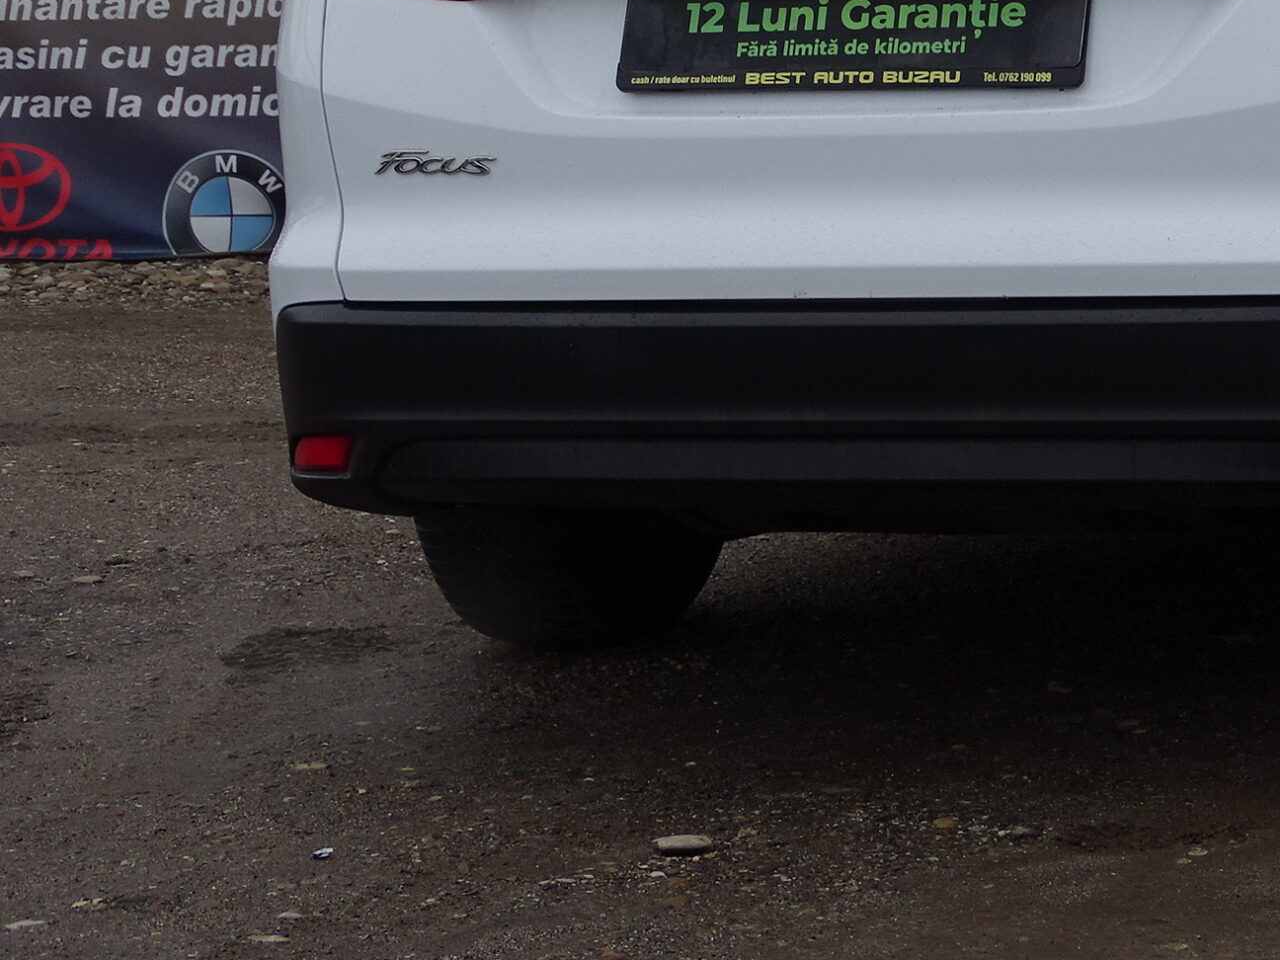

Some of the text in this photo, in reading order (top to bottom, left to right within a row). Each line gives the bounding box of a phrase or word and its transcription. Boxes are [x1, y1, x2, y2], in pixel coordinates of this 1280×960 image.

[686, 2, 725, 34] 12
[101, 45, 151, 69] cu
[736, 36, 967, 58] Fără limită de kilometri
[630, 75, 650, 85] cash
[655, 75, 671, 84] rate
[671, 75, 690, 84] doar
[690, 76, 700, 84] cu
[745, 70, 961, 85] BEST AUTO BUZAU
[983, 72, 998, 82] Tel.
[998, 72, 1019, 82] 0762
[105, 87, 143, 118] la
[176, 154, 283, 194] BMW
